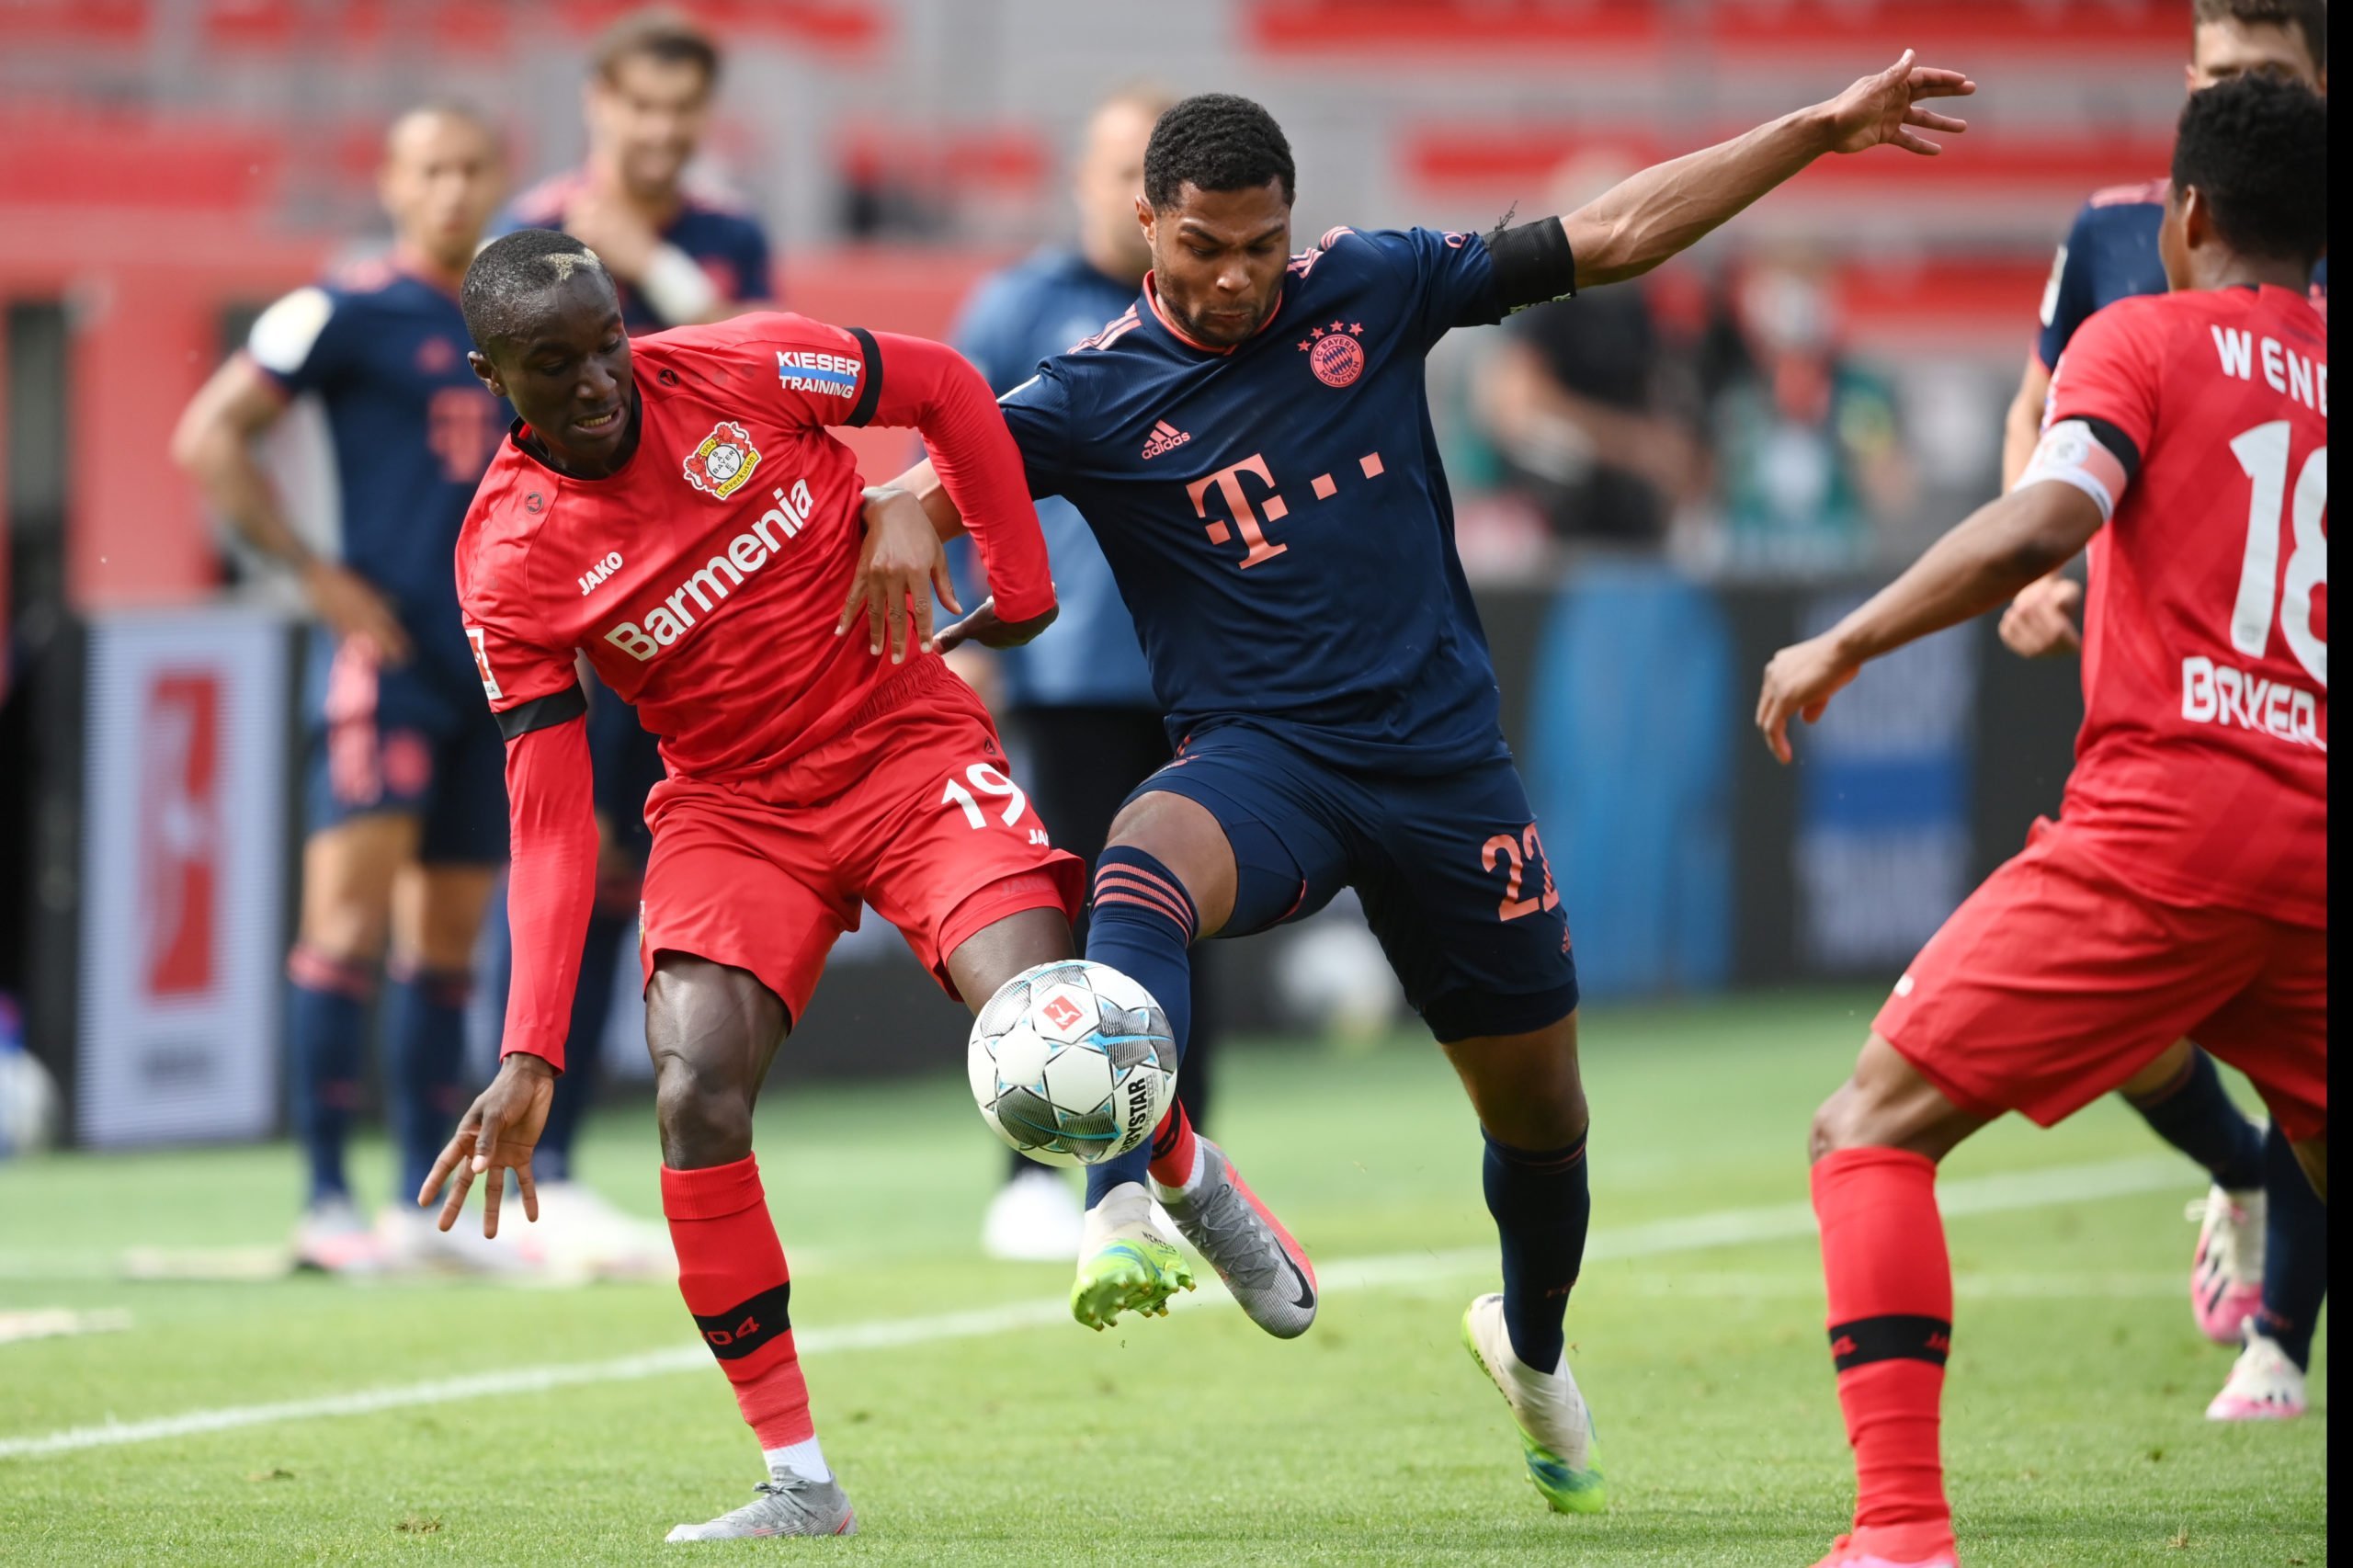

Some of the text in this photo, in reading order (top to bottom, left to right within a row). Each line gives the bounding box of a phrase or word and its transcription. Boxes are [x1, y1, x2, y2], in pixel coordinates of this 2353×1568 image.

[1314, 338, 1358, 362] FC BAYERN
[776, 351, 861, 377] KIESER
[779, 375, 855, 399] TRAINING
[701, 440, 716, 456] 1904
[1142, 431, 1191, 460] adidas
[711, 450, 736, 473] BAYER
[712, 449, 735, 475] BAYER
[719, 456, 756, 494] Leverkusen
[577, 551, 623, 597] JAKO
[603, 478, 814, 662] Barmenia
[941, 763, 1026, 830] 19
[1481, 822, 1560, 922] 22
